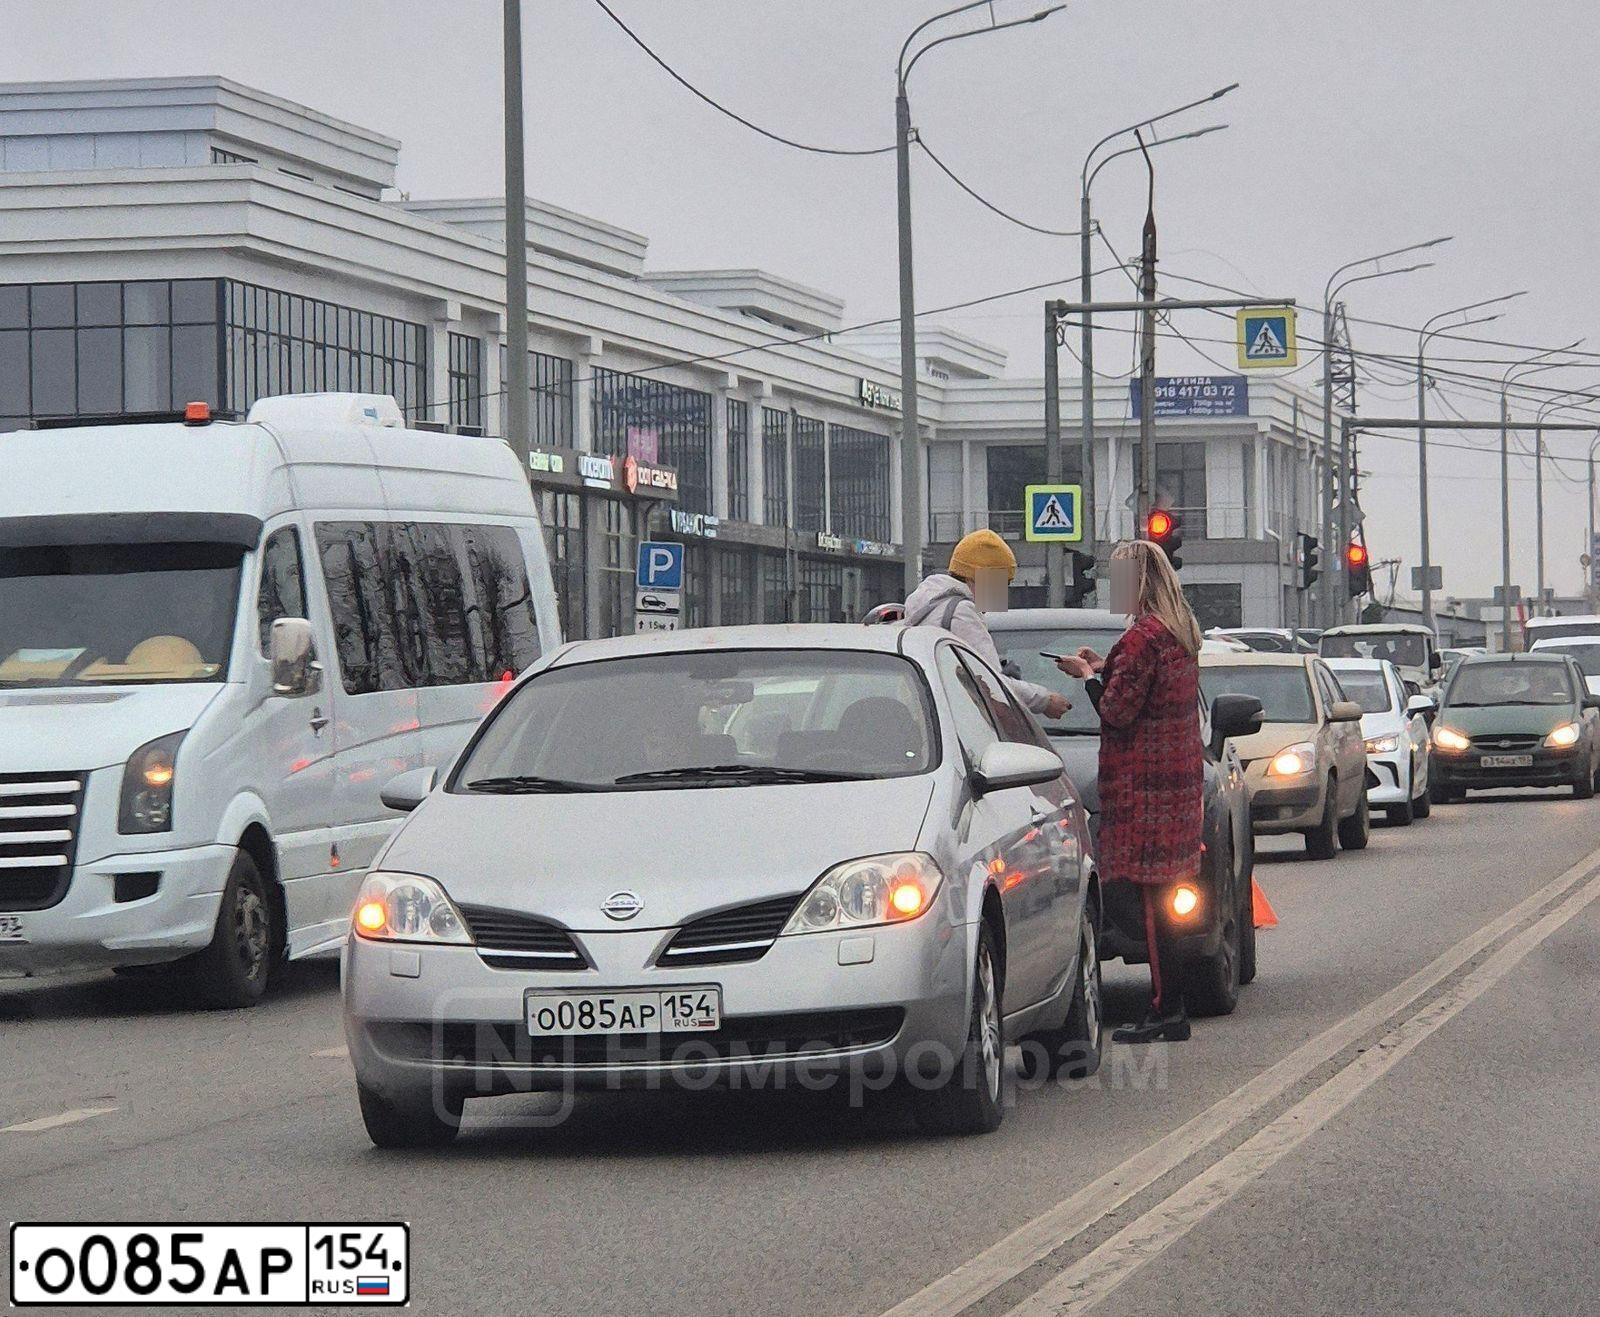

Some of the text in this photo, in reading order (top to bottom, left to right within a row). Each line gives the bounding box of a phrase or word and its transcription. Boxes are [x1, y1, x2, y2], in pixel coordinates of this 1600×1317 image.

[1178, 386, 1200, 397] 417
[1203, 386, 1218, 396] 03
[1221, 385, 1235, 396] 72
[649, 549, 673, 583] P
[603, 899, 640, 907] NISSAN
[537, 994, 711, 1031] О085АР 154
[674, 1017, 699, 1028] RUS
